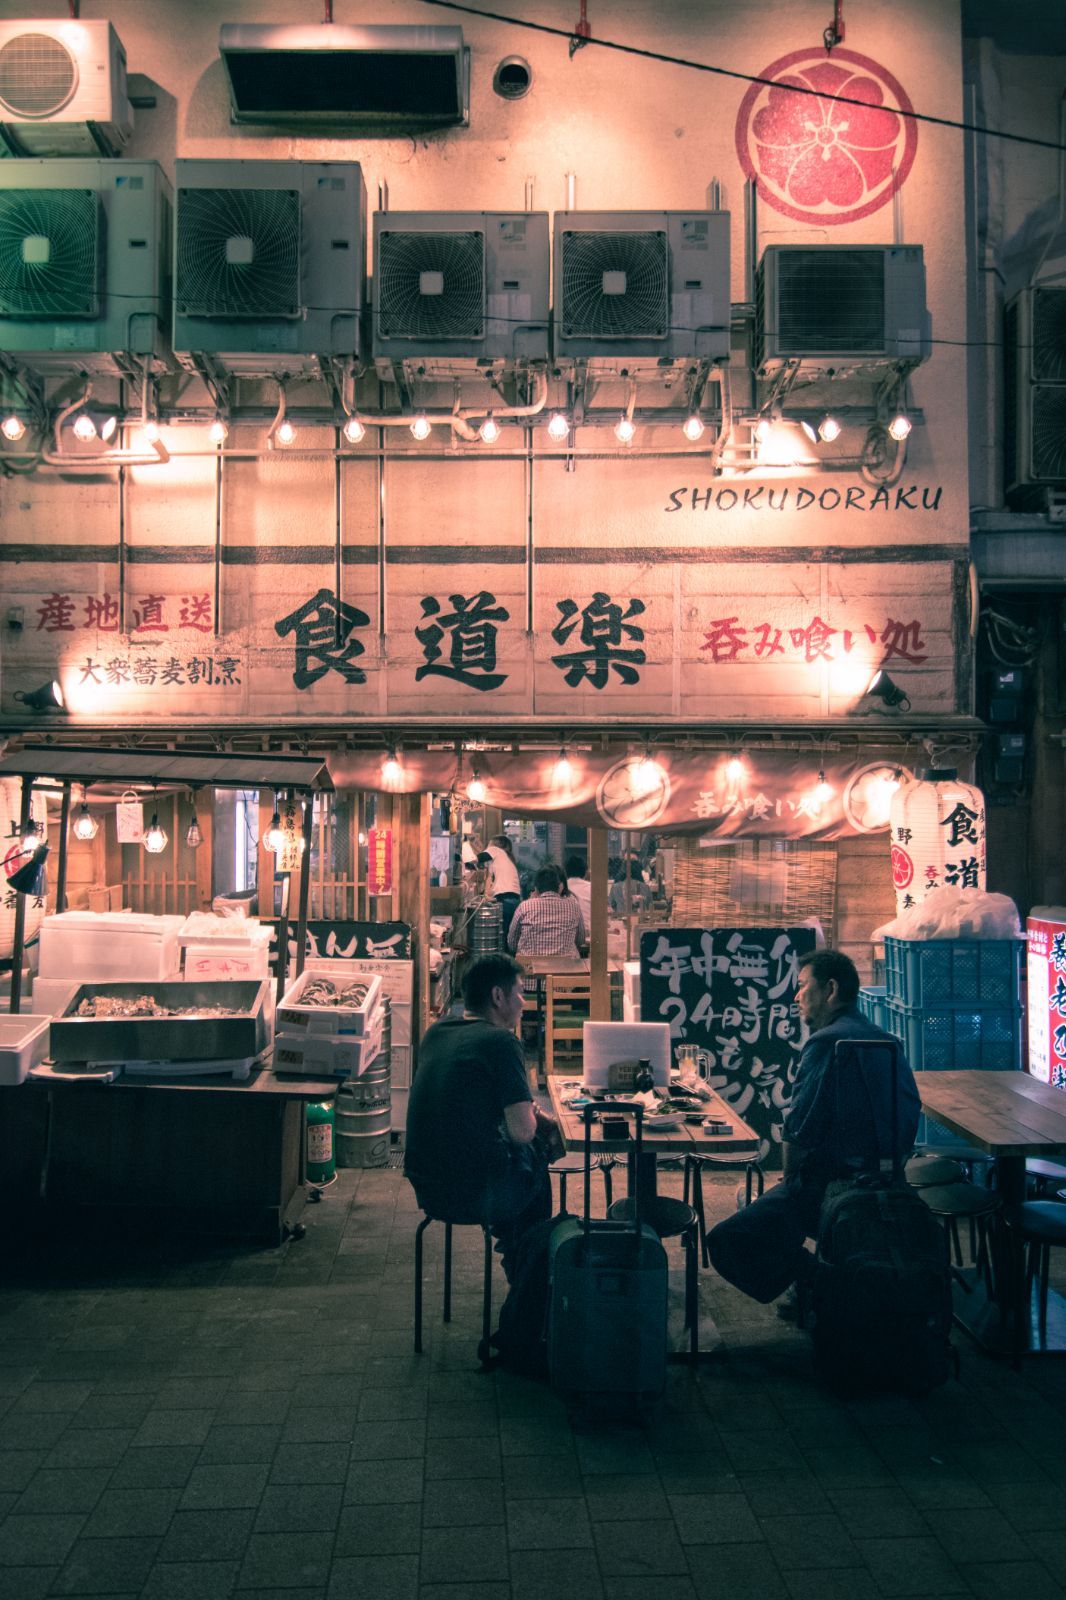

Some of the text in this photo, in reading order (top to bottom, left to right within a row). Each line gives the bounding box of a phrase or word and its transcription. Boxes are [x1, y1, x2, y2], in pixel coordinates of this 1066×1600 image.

[665, 486, 944, 513] SHOKUDORAKU
[36, 592, 214, 633] 産地直送
[274, 588, 646, 692] 食道楽
[700, 616, 929, 665] 呑み喰い処
[79, 656, 242, 687] 大衆蕎麦割烹
[647, 932, 800, 1000] 年中無休
